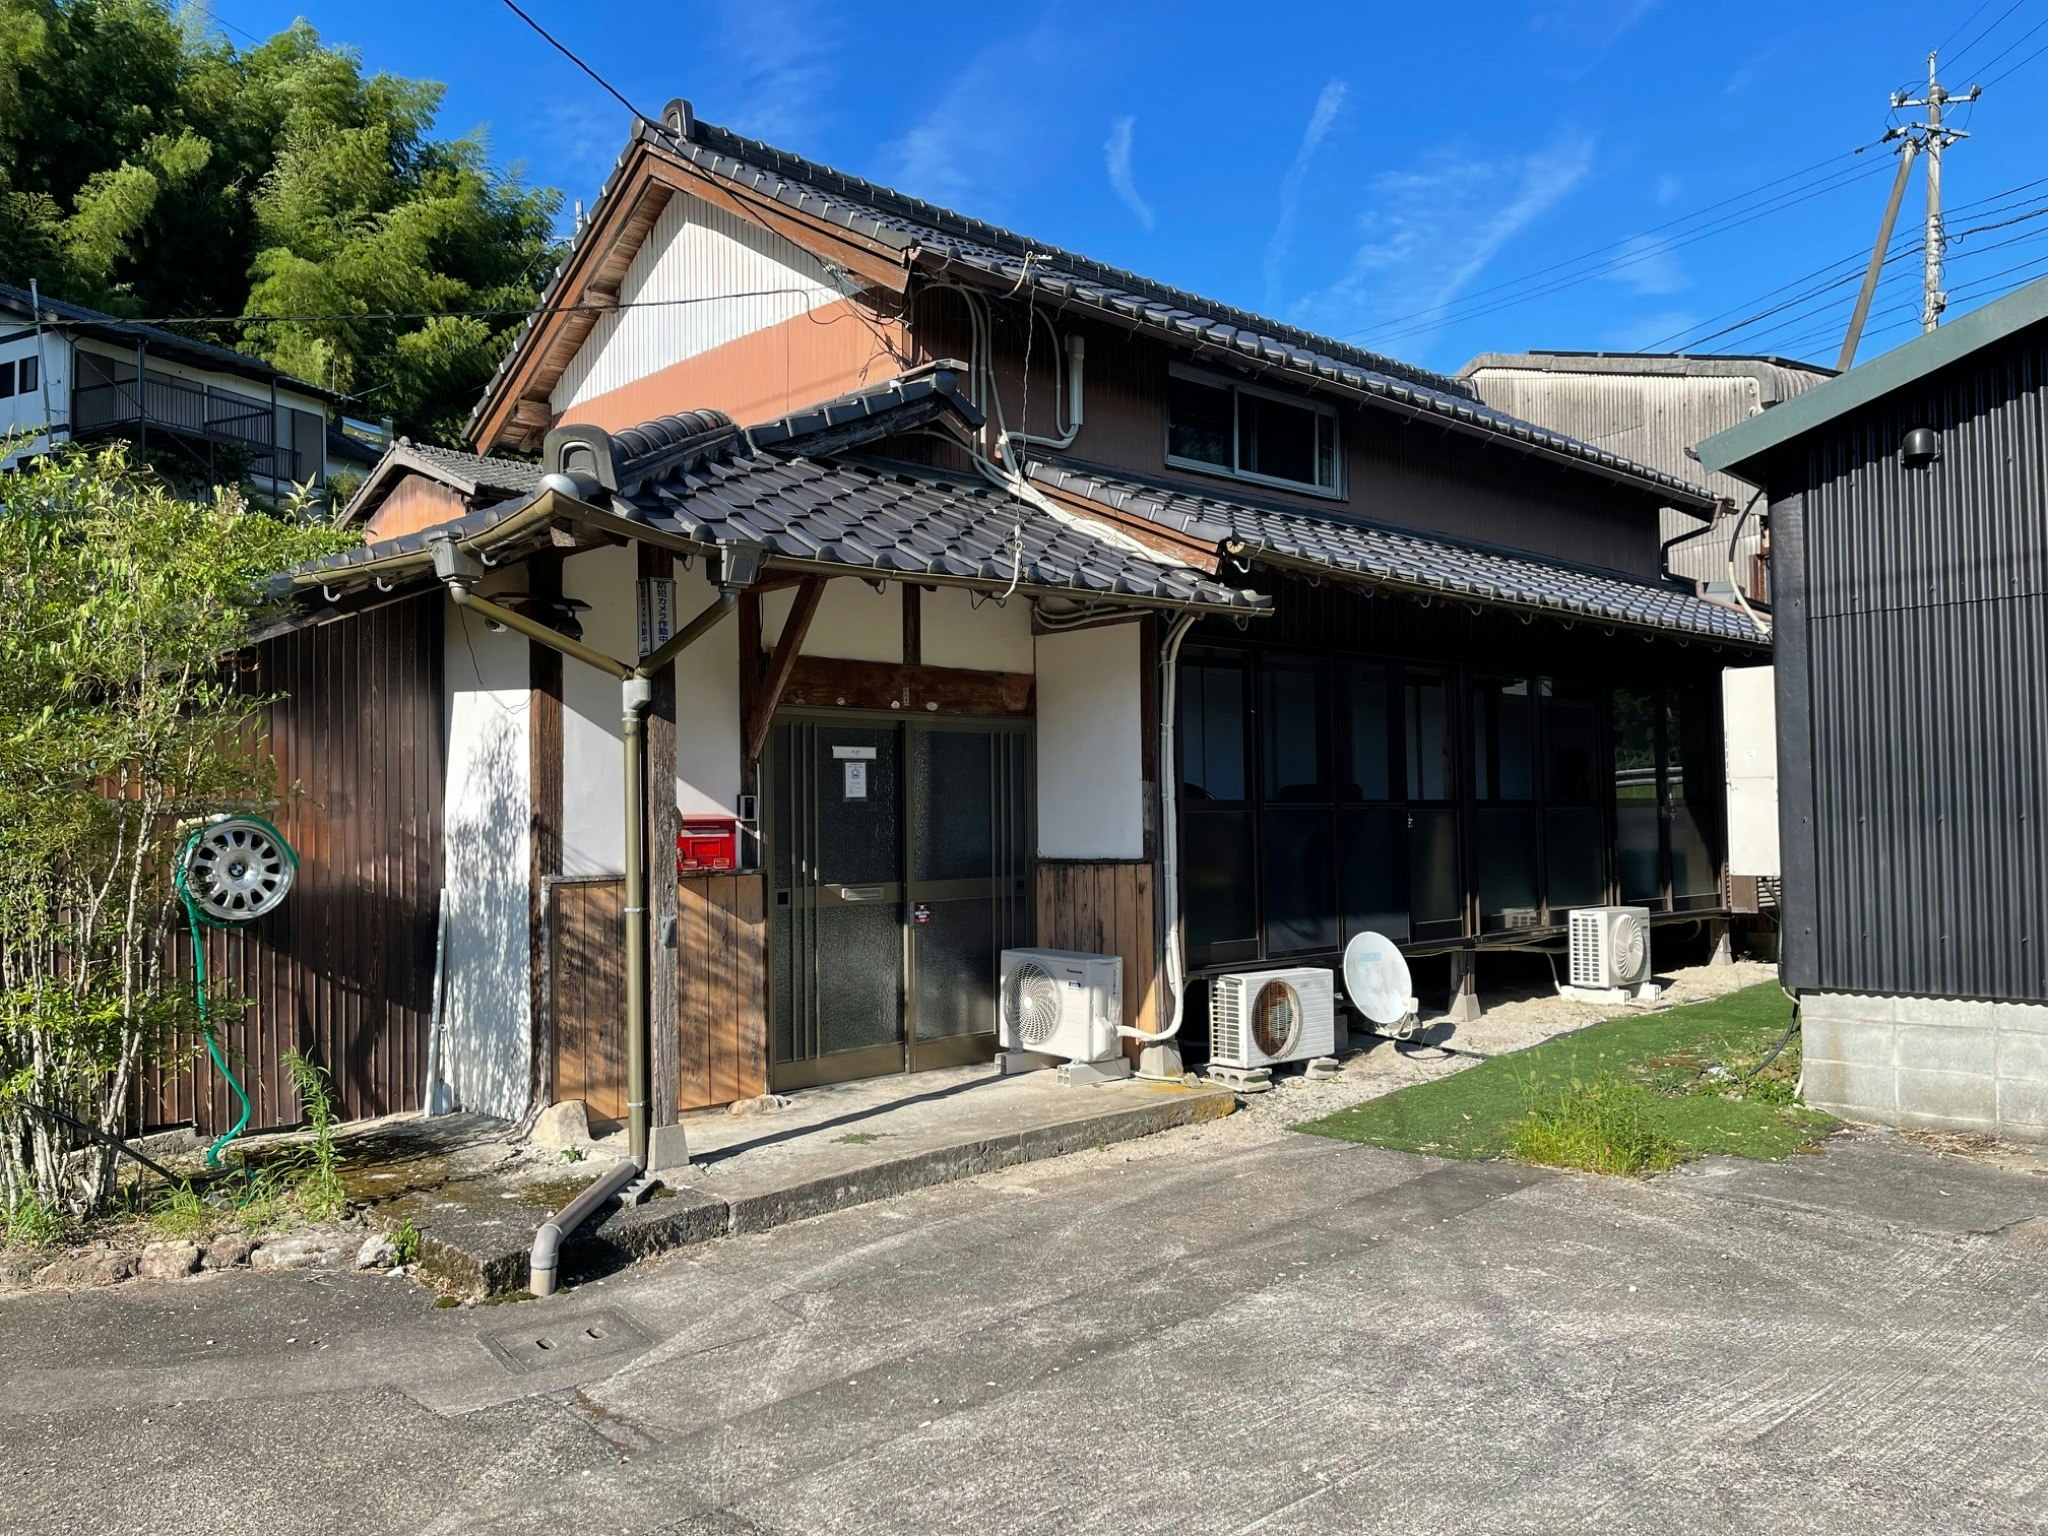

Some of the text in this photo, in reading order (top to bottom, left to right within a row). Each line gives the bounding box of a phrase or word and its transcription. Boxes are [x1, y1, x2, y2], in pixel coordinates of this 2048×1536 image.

[657, 580, 669, 643] 防犯カメラ作動中
